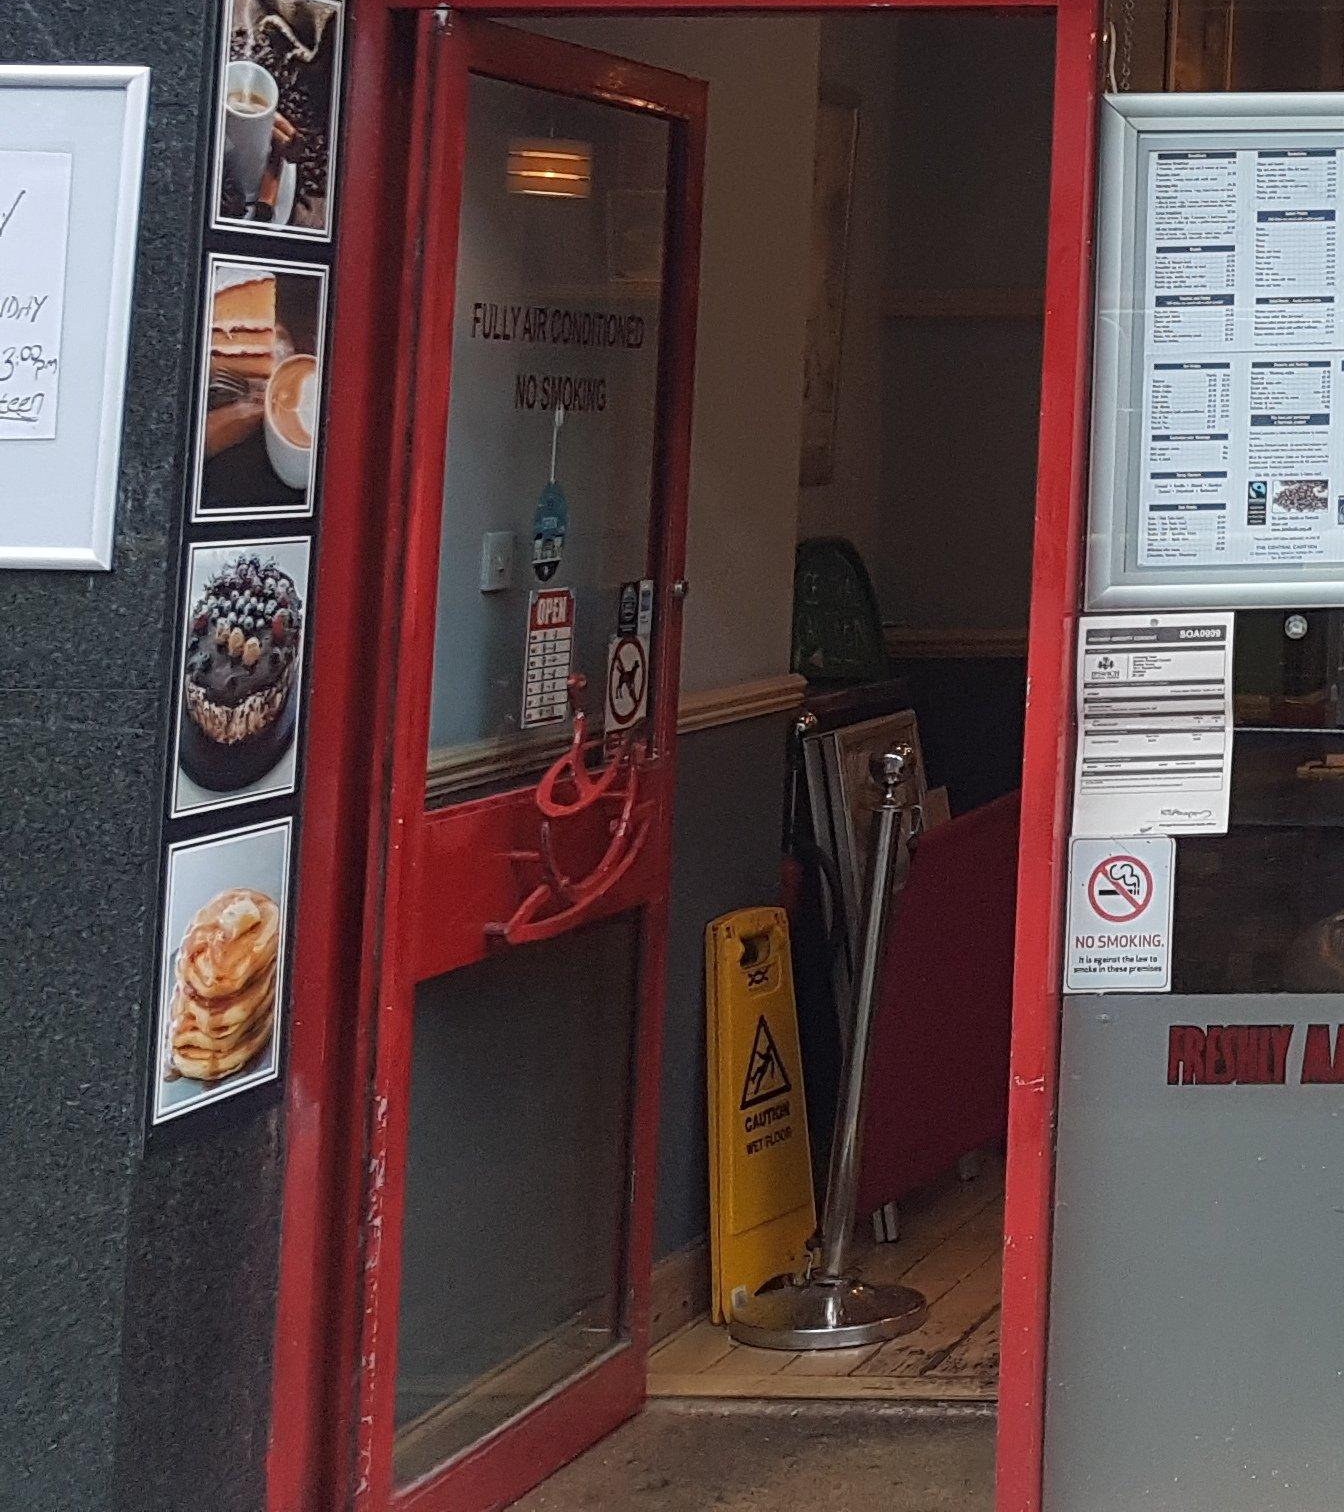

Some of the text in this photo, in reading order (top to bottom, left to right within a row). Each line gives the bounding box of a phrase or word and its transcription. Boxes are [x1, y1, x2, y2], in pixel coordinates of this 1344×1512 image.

[471, 302, 646, 349] FULLY AIR CONDITIONED
[514, 374, 608, 412] NO SMOKING
[536, 596, 568, 626] OPEN
[1075, 935, 1095, 949] NO
[1093, 955, 1121, 966] against
[1122, 955, 1135, 963] the
[1107, 964, 1128, 973] these
[744, 1099, 791, 1133] CAUTION
[745, 1137, 763, 1156] WET
